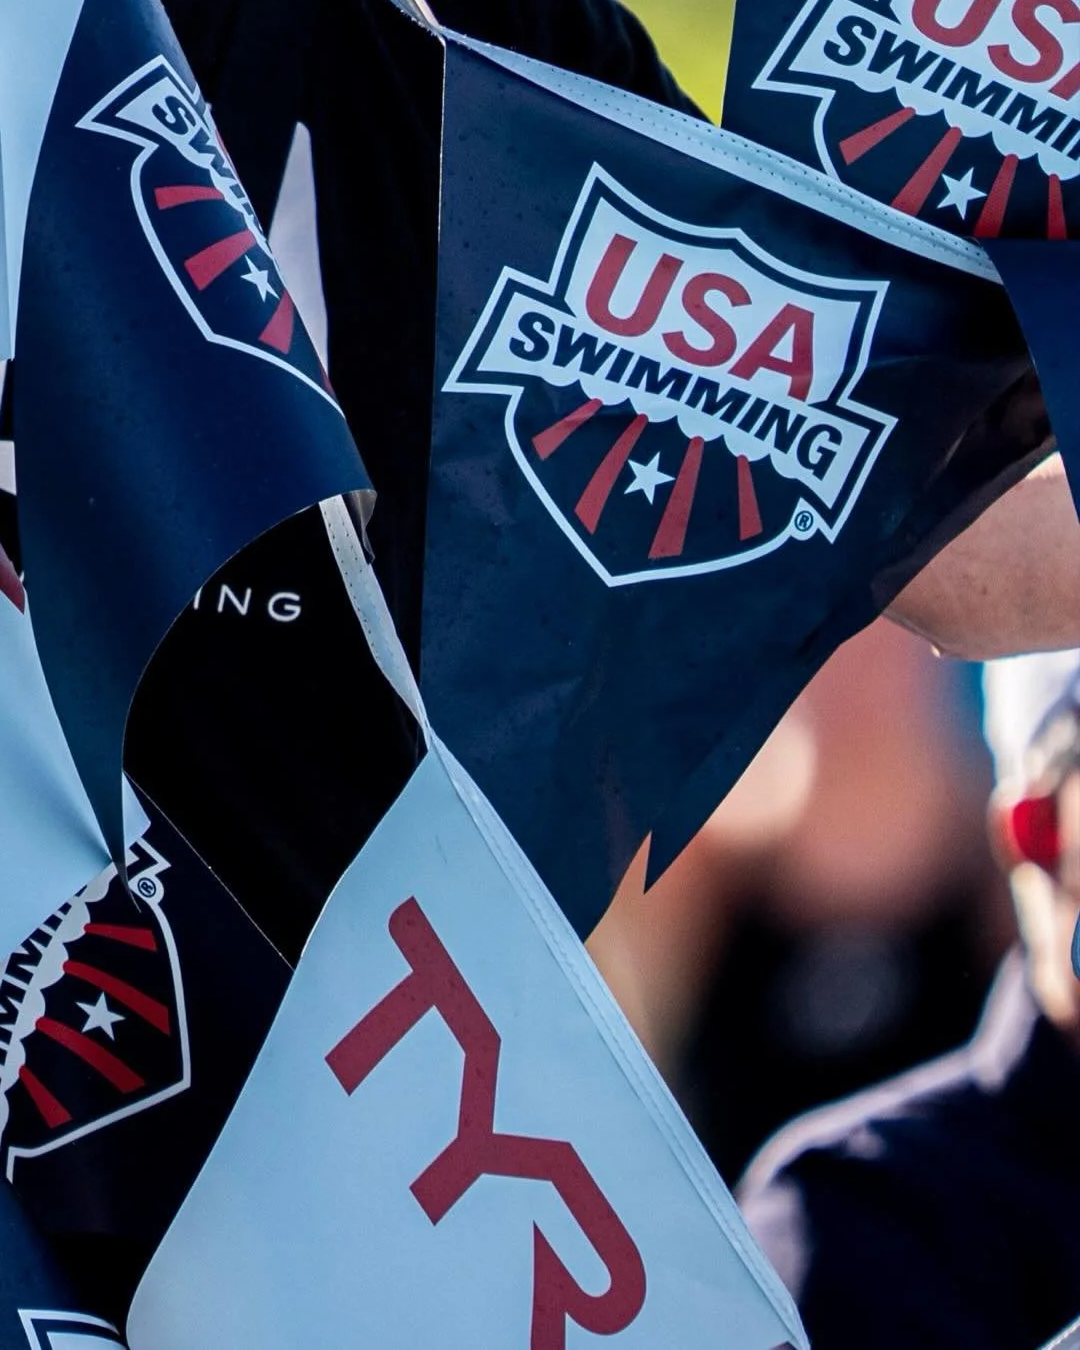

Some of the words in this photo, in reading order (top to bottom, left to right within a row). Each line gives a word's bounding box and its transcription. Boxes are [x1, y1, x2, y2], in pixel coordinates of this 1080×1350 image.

[509, 311, 843, 481] SWIMMING
[585, 233, 815, 401] USA
[324, 895, 647, 1350] TYR
